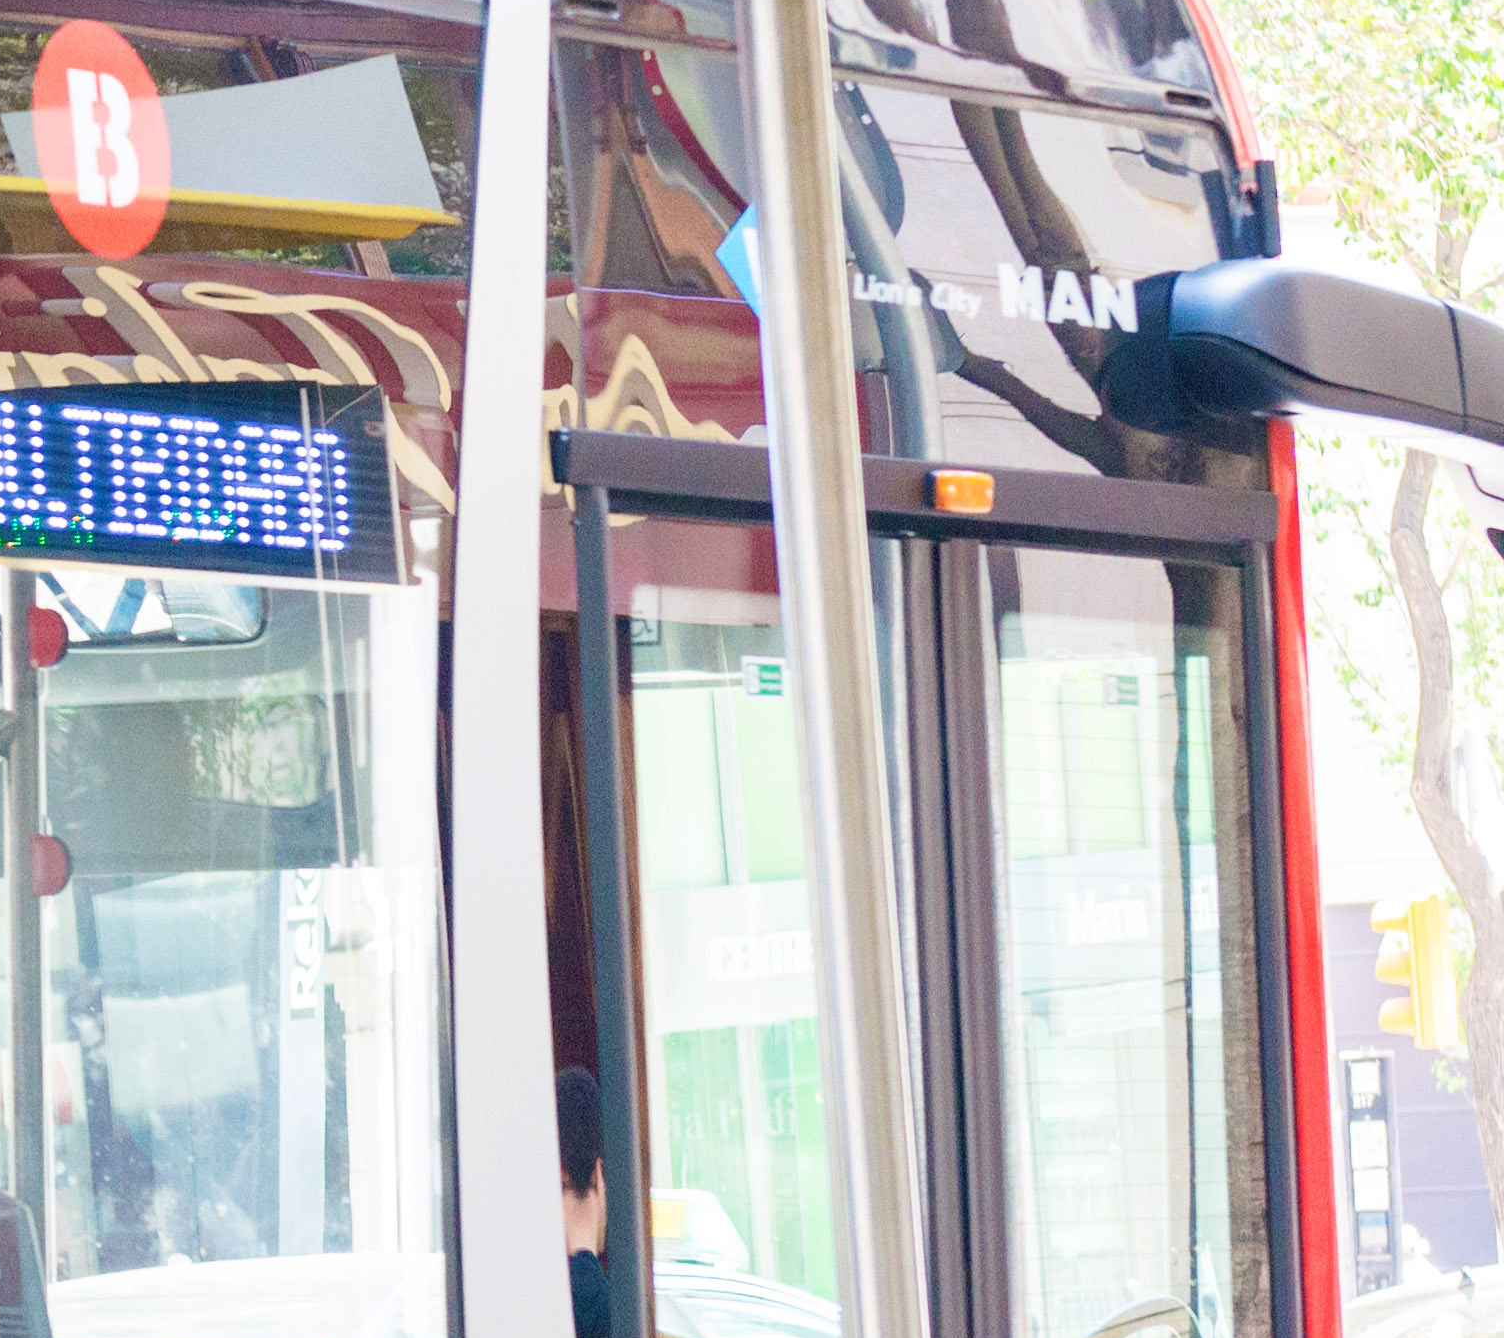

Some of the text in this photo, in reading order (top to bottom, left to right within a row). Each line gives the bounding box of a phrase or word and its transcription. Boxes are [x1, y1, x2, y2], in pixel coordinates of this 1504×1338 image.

[64, 67, 141, 209] B
[854, 260, 1139, 333] Lion's City MAN
